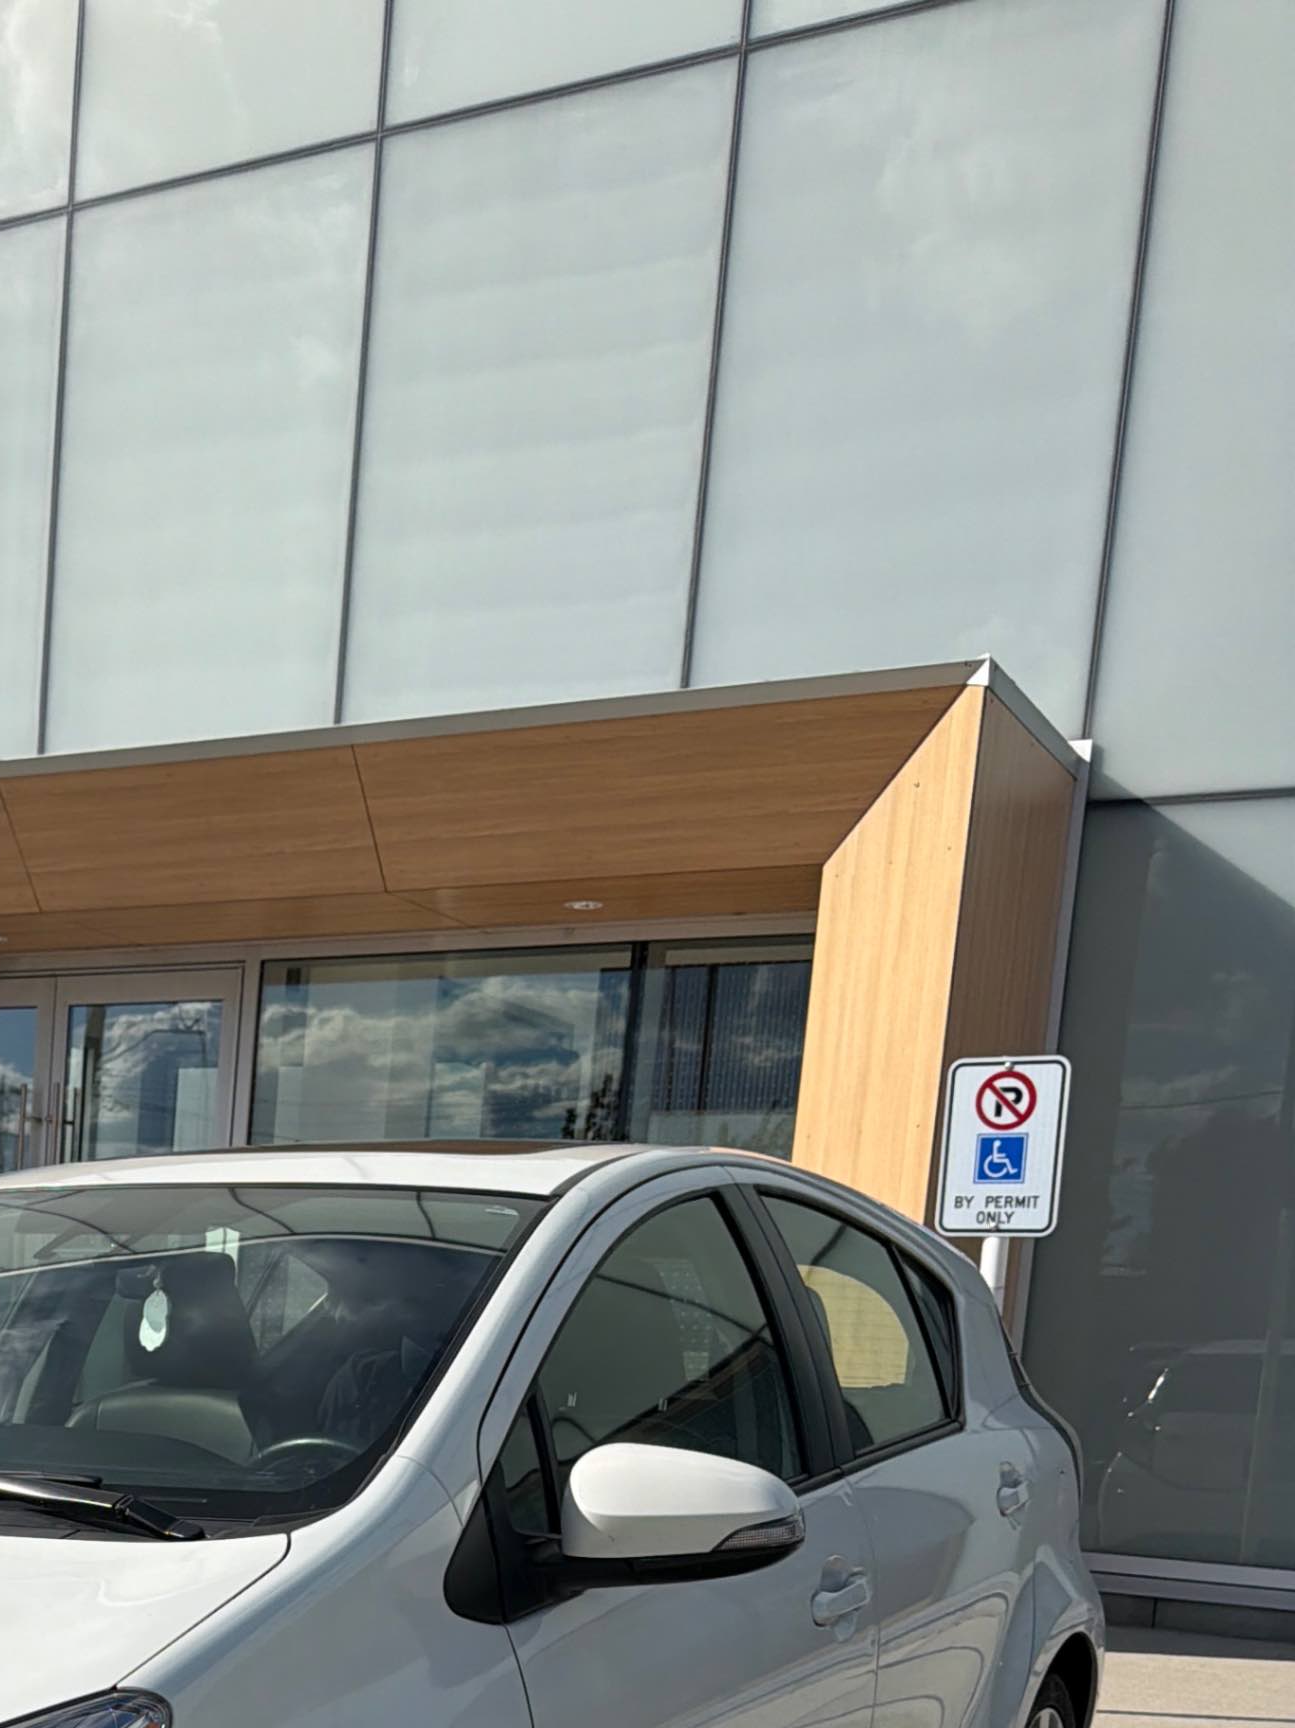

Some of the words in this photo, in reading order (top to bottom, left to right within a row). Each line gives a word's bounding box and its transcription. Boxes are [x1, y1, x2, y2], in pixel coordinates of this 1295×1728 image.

[954, 1195, 975, 1209] BY
[984, 1195, 1040, 1209] PERMIT
[976, 1211, 1015, 1225] ONLY
